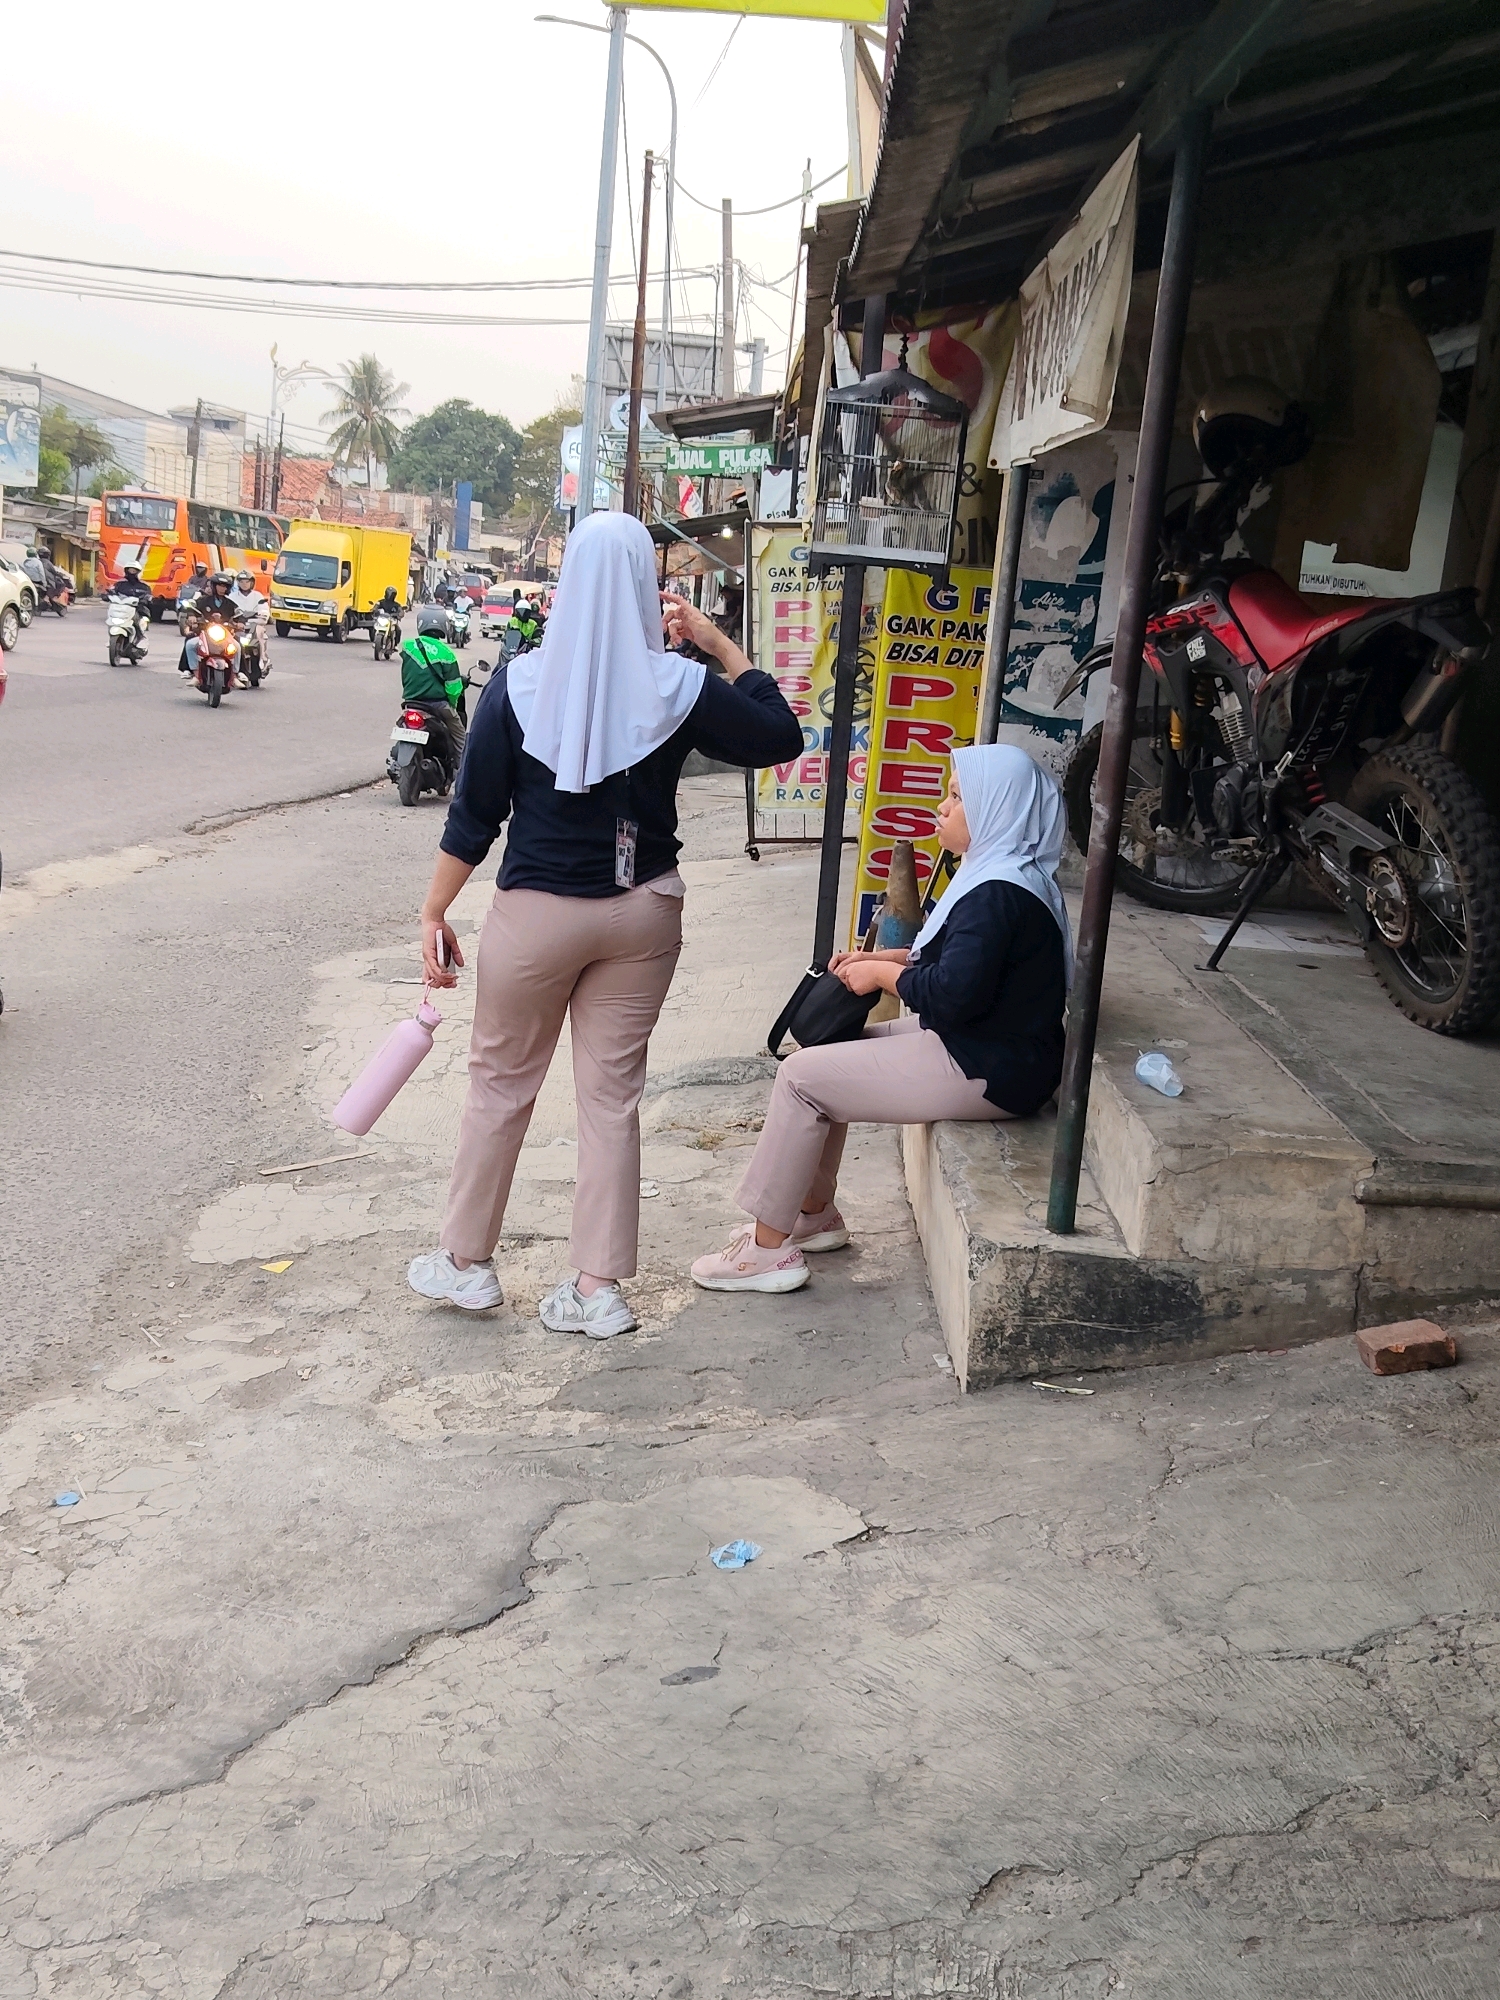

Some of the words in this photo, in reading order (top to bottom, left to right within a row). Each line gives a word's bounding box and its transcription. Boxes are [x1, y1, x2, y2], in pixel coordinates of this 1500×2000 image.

[668, 447, 712, 470] JUAL
[719, 447, 772, 468] PULSA
[768, 566, 797, 578] GAK
[770, 582, 801, 593] BISA
[1032, 591, 1066, 607] Aice
[886, 615, 936, 637] GAK
[885, 642, 939, 665] BISA
